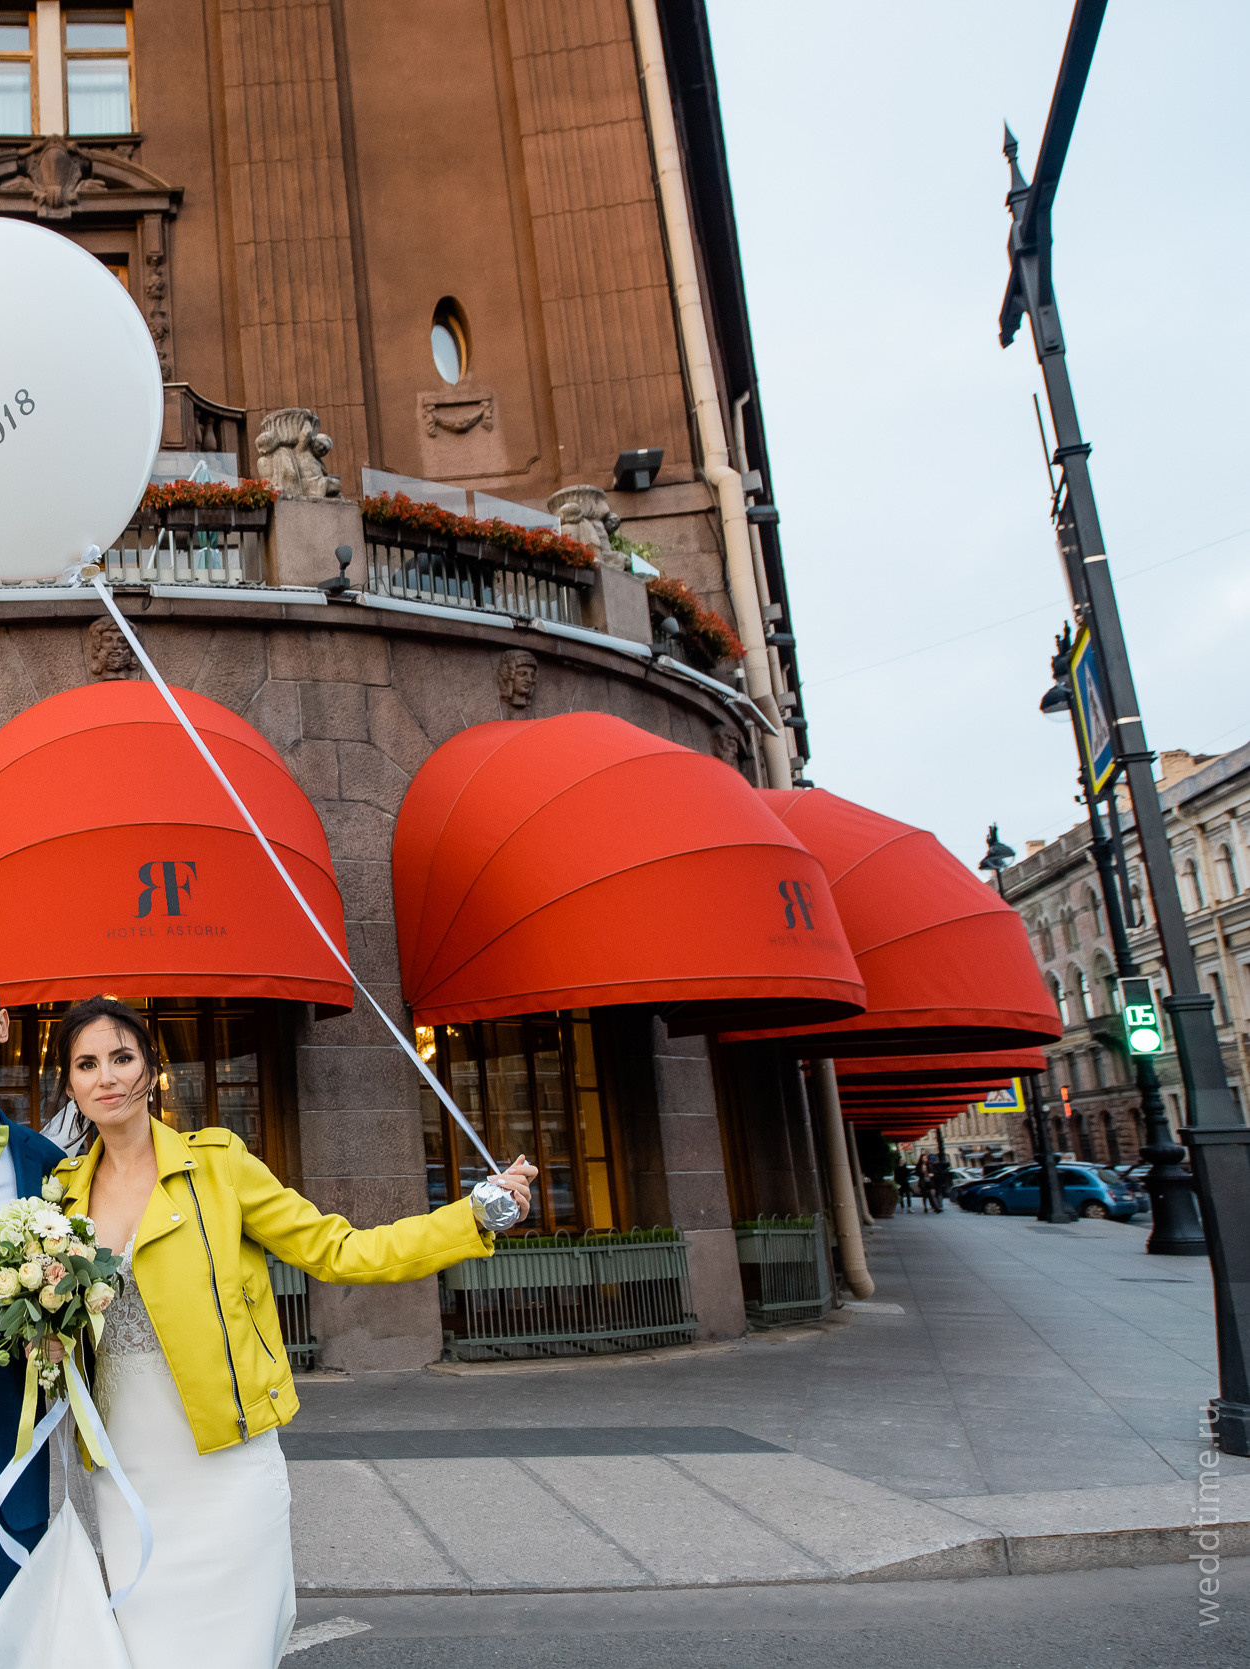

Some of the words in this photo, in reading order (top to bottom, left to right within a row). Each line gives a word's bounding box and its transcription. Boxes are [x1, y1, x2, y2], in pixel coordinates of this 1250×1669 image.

[107, 926, 156, 939] HOTEL
[166, 925, 228, 937] ASTORIA
[1125, 1004, 1156, 1026] 05
